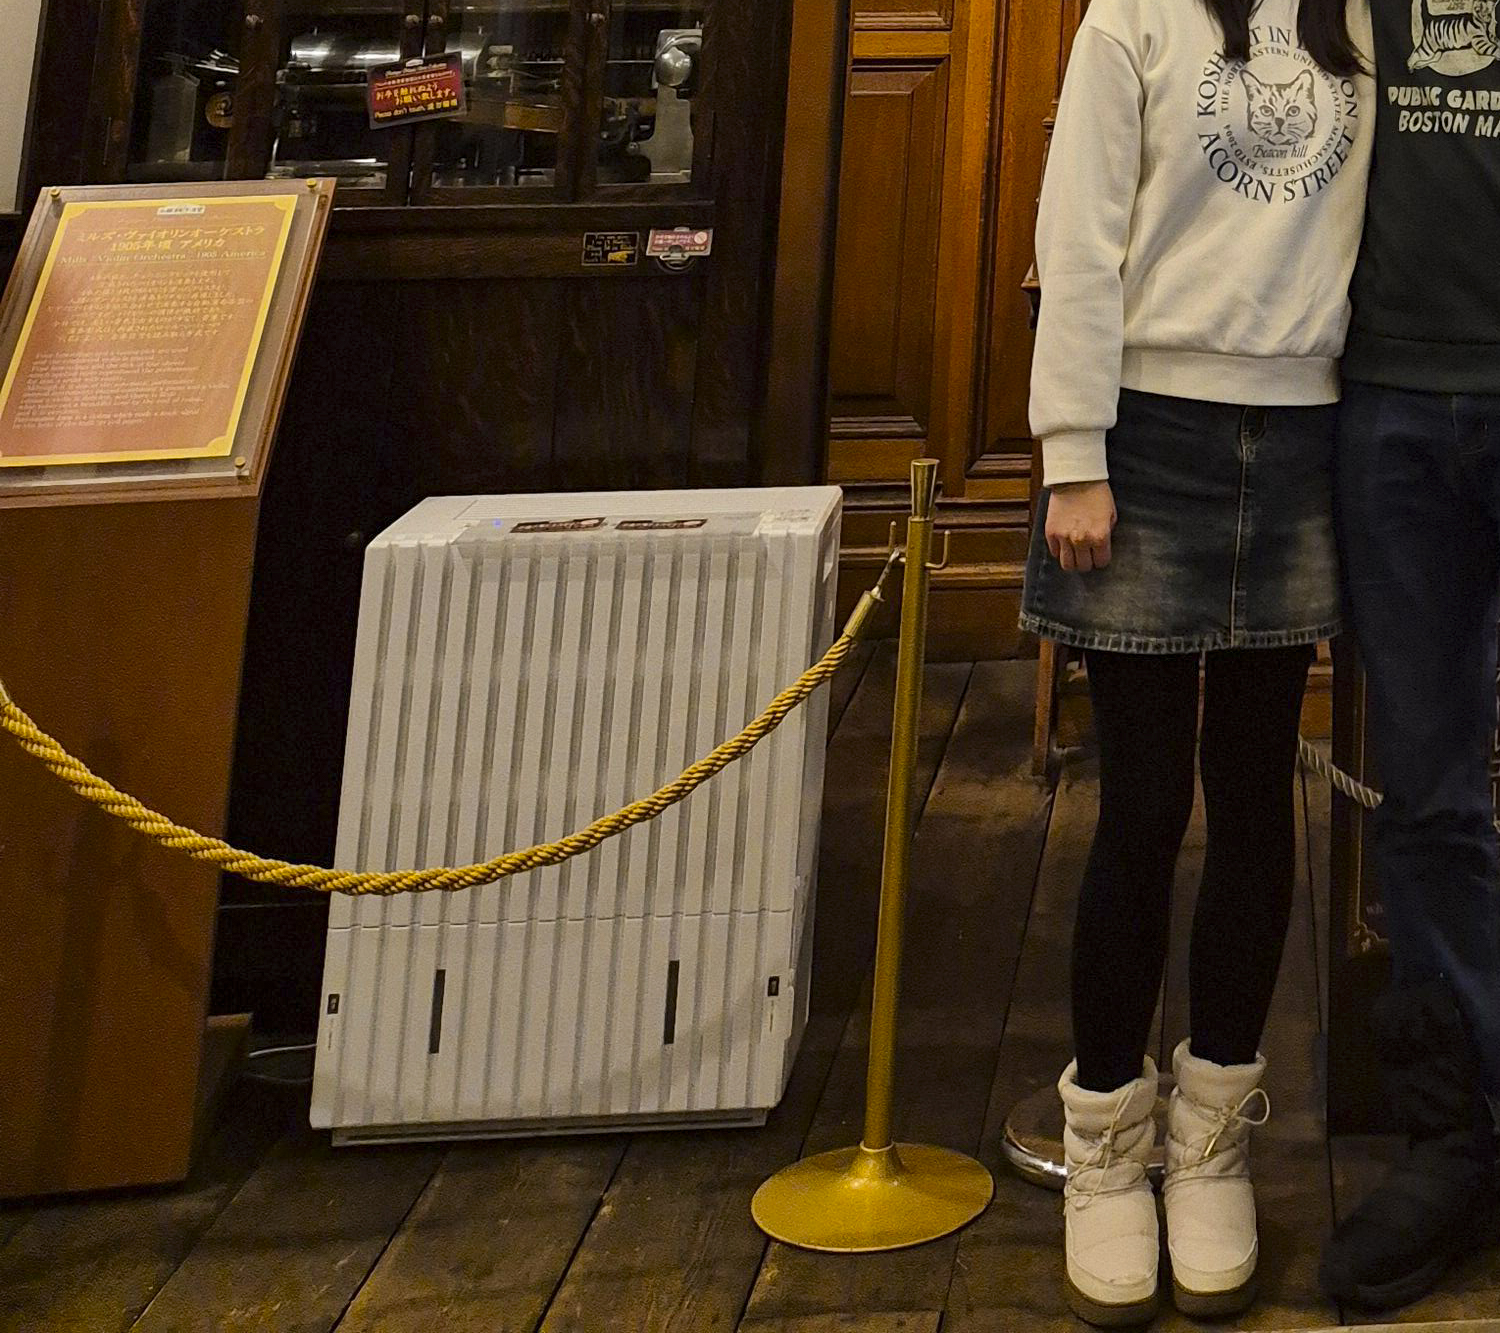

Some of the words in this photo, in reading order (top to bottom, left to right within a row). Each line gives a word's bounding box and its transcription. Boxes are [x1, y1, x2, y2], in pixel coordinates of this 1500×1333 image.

[1197, 26, 1262, 118] KOSHT
[1267, 25, 1292, 46] IN
[1221, 88, 1230, 113] THE
[1328, 82, 1342, 123] STATES
[1398, 110, 1470, 134] BOSTON
[1252, 144, 1288, 159] Beacon
[1198, 133, 1276, 204] ACORN
[1283, 126, 1354, 204] STREET
[77, 225, 265, 242] ミルズ・ヴァイオリンオーケストラ
[179, 238, 226, 250] アメリカ
